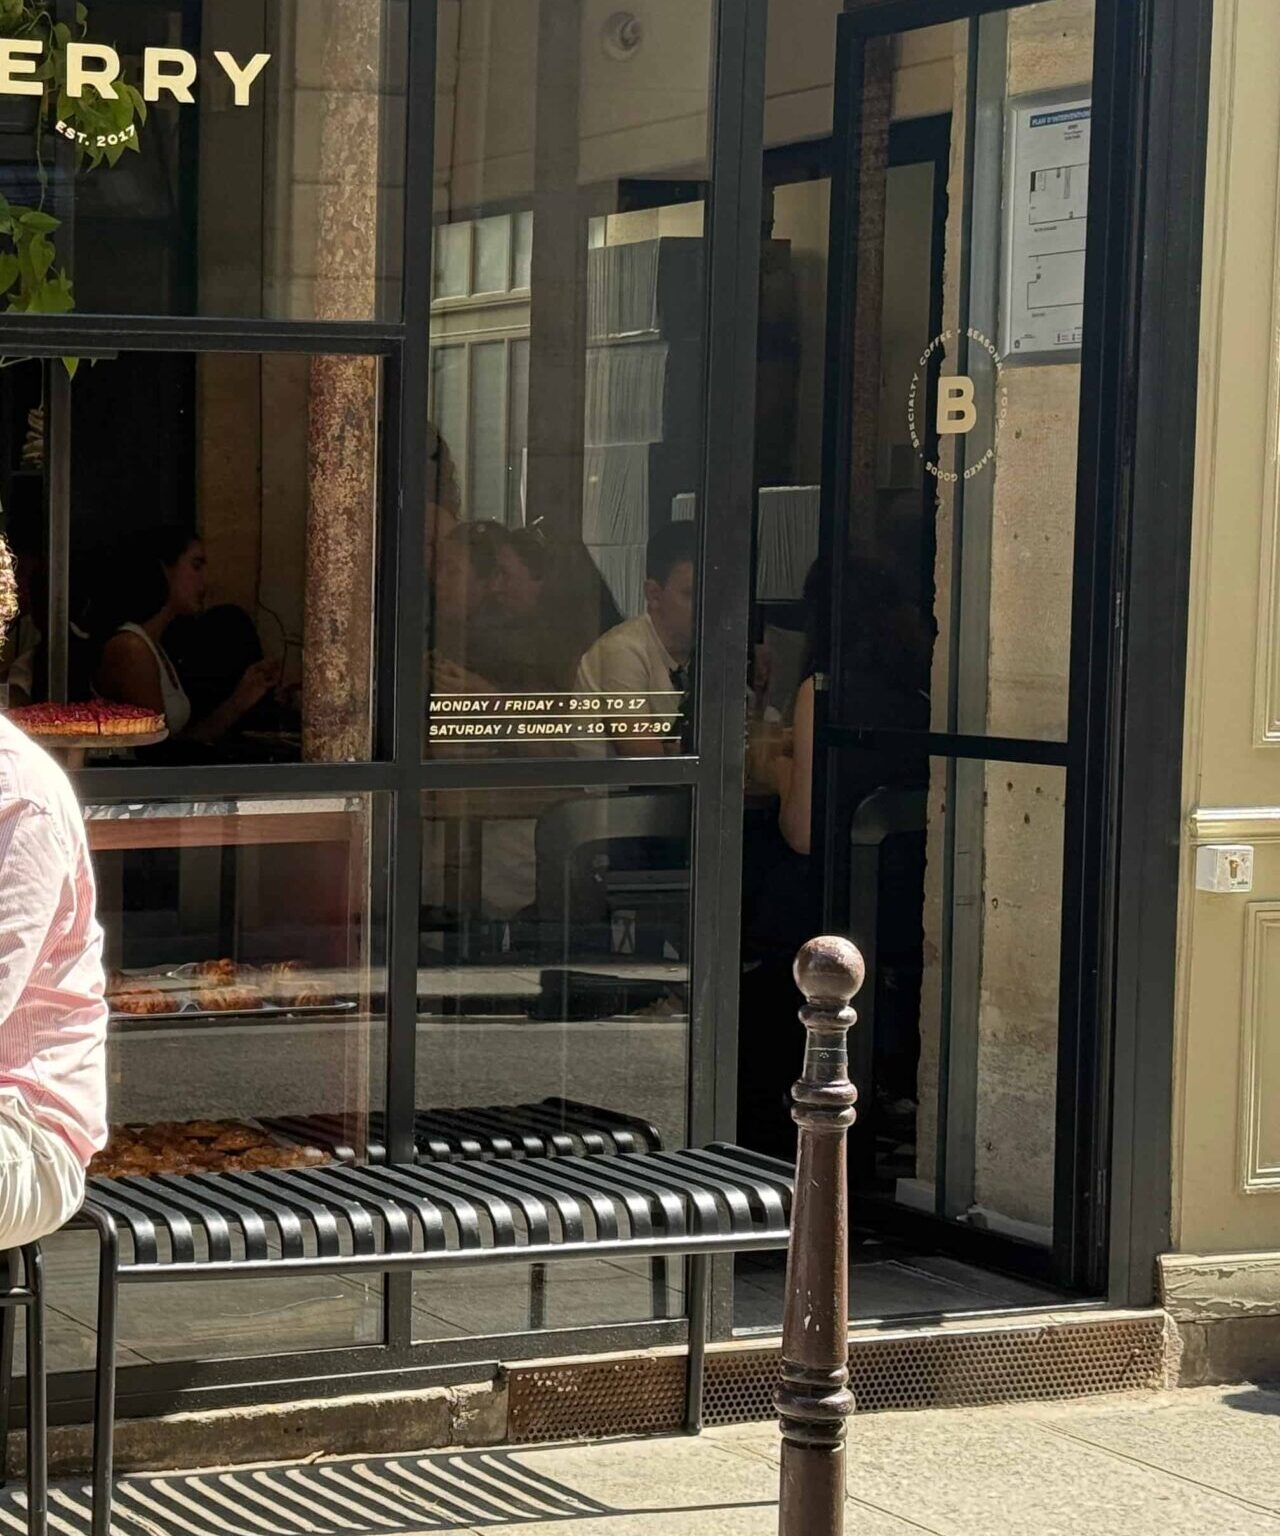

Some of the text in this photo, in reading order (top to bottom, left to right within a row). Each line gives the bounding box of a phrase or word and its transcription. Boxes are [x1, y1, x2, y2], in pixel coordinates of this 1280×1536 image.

[55, 120, 135, 147] EST. 2017
[919, 329, 953, 367] COFFEE
[907, 372, 920, 449] SPECIALTY
[936, 375, 977, 435] B
[926, 461, 959, 483] GOODS
[963, 448, 994, 480] BAKED
[428, 700, 489, 713] MONDAY
[504, 700, 554, 711] FRIDAY
[569, 699, 601, 710] 9:30
[606, 699, 623, 710] TO
[628, 698, 646, 709] 17
[428, 723, 502, 736] SATURDAY
[516, 723, 572, 735] SUNDAY
[586, 722, 605, 734] 10
[610, 722, 628, 733] TO
[632, 721, 671, 733] 17:30
